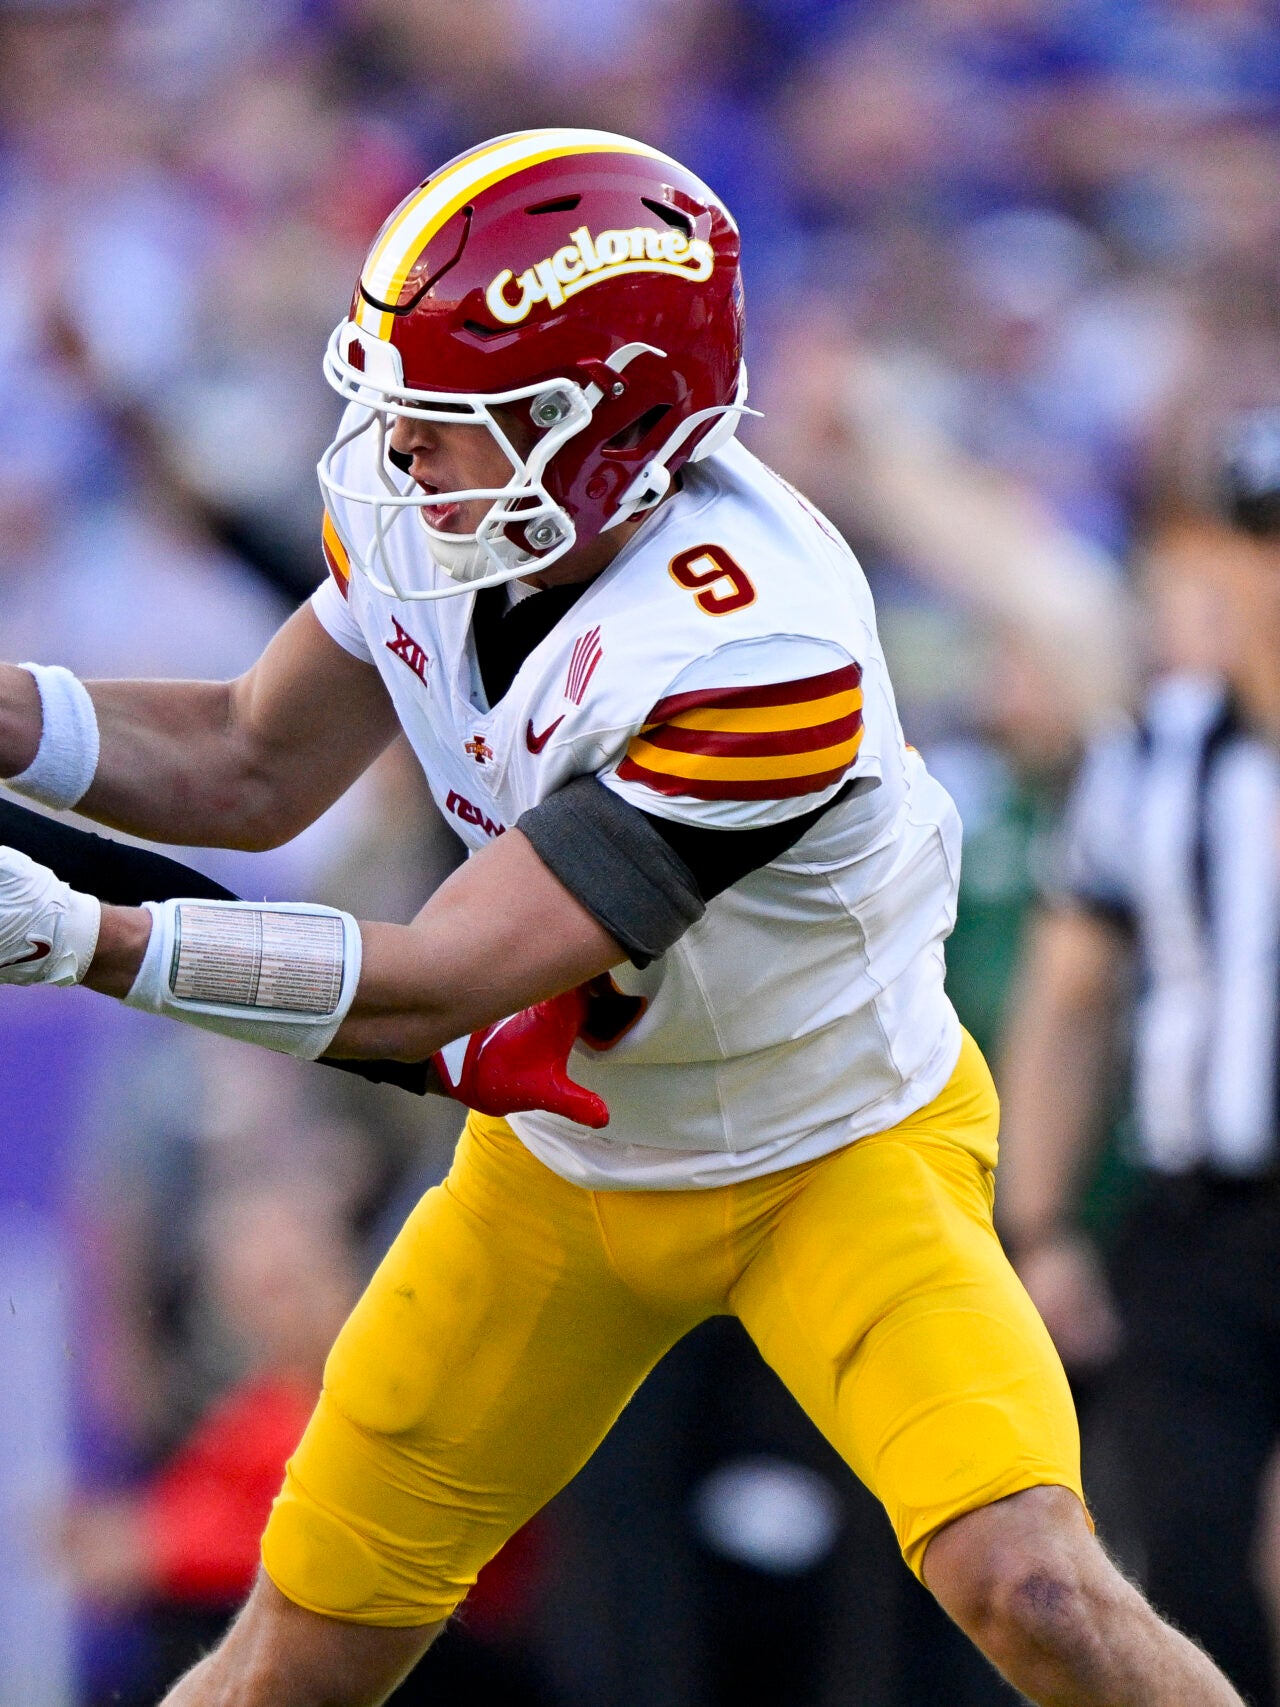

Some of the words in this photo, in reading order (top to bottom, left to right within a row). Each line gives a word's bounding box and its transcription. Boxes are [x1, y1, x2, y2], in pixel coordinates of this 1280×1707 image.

[486, 226, 714, 324] Cyclones
[668, 543, 758, 617] 9
[385, 614, 429, 688] XII
